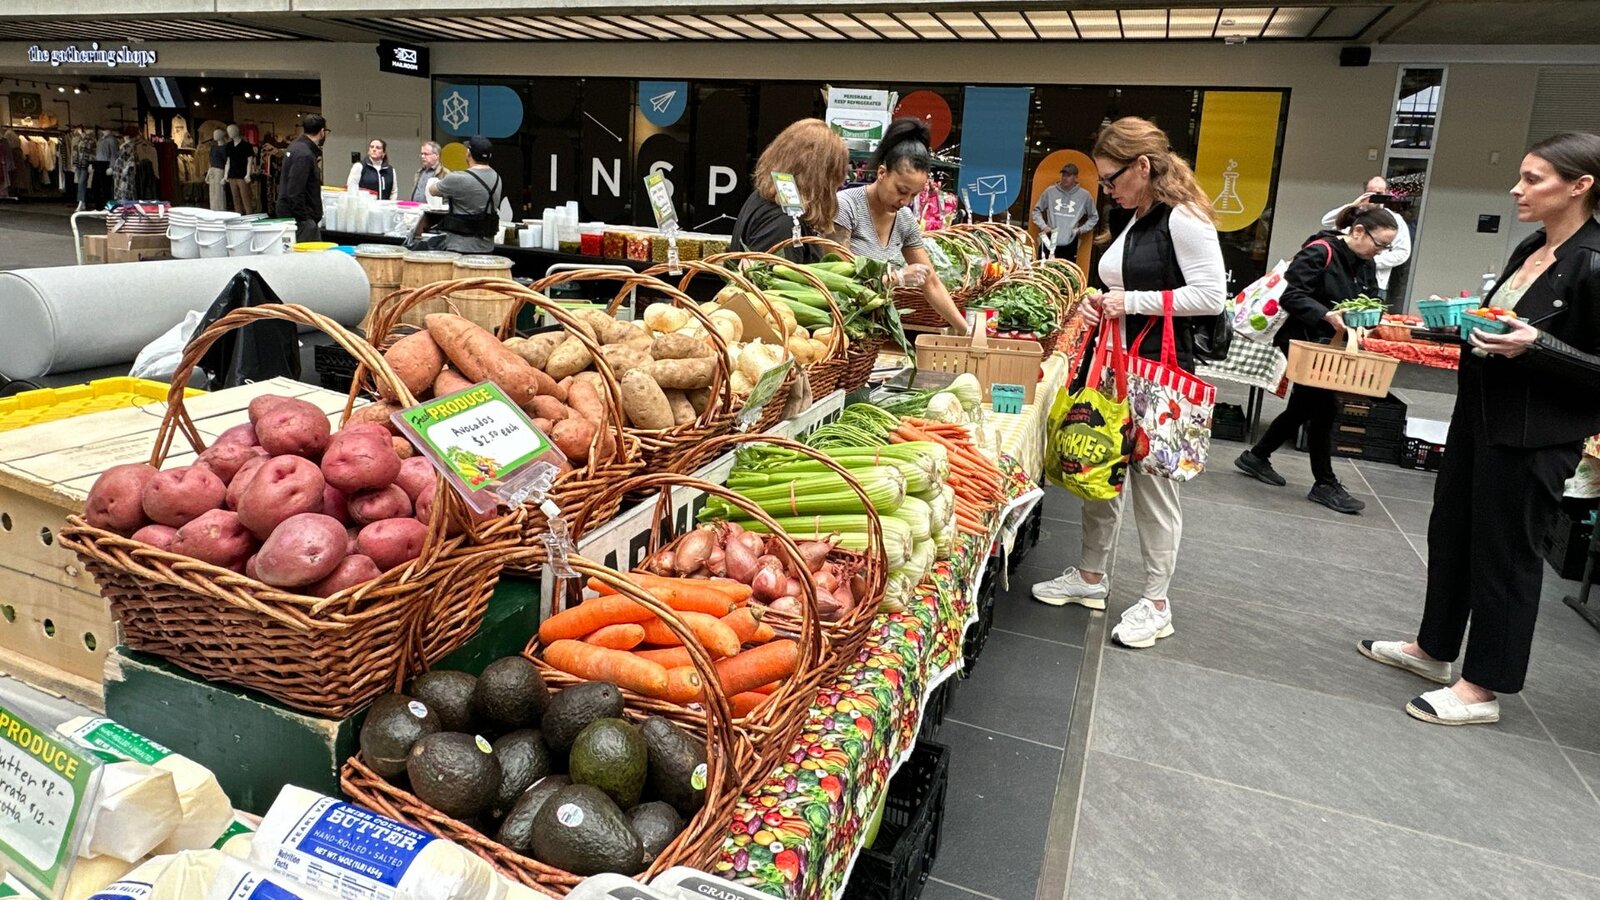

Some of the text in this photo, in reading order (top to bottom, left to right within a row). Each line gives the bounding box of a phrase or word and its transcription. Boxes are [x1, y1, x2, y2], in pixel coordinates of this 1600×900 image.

[28, 42, 157, 67] the gathering shops
[391, 60, 419, 70] MAILROOM
[427, 388, 493, 420] PRODUCE
[450, 414, 495, 438] Avocados
[471, 423, 519, 447] $2.50 each
[0, 712, 79, 780] PRODUCE
[0, 754, 37, 786] utter
[0, 778, 27, 804] rrata
[0, 800, 21, 823] otta
[337, 805, 426, 840] AMISH COUNTRY
[290, 816, 316, 843] PEARL
[325, 809, 418, 851] BUTTER
[278, 849, 301, 865] Nutrition
[313, 830, 404, 868] HAND-ROLLED SALTED
[274, 857, 289, 870] Facts
[314, 846, 328, 856] NET
[326, 850, 338, 861] WT.
[366, 866, 383, 879] 454g
